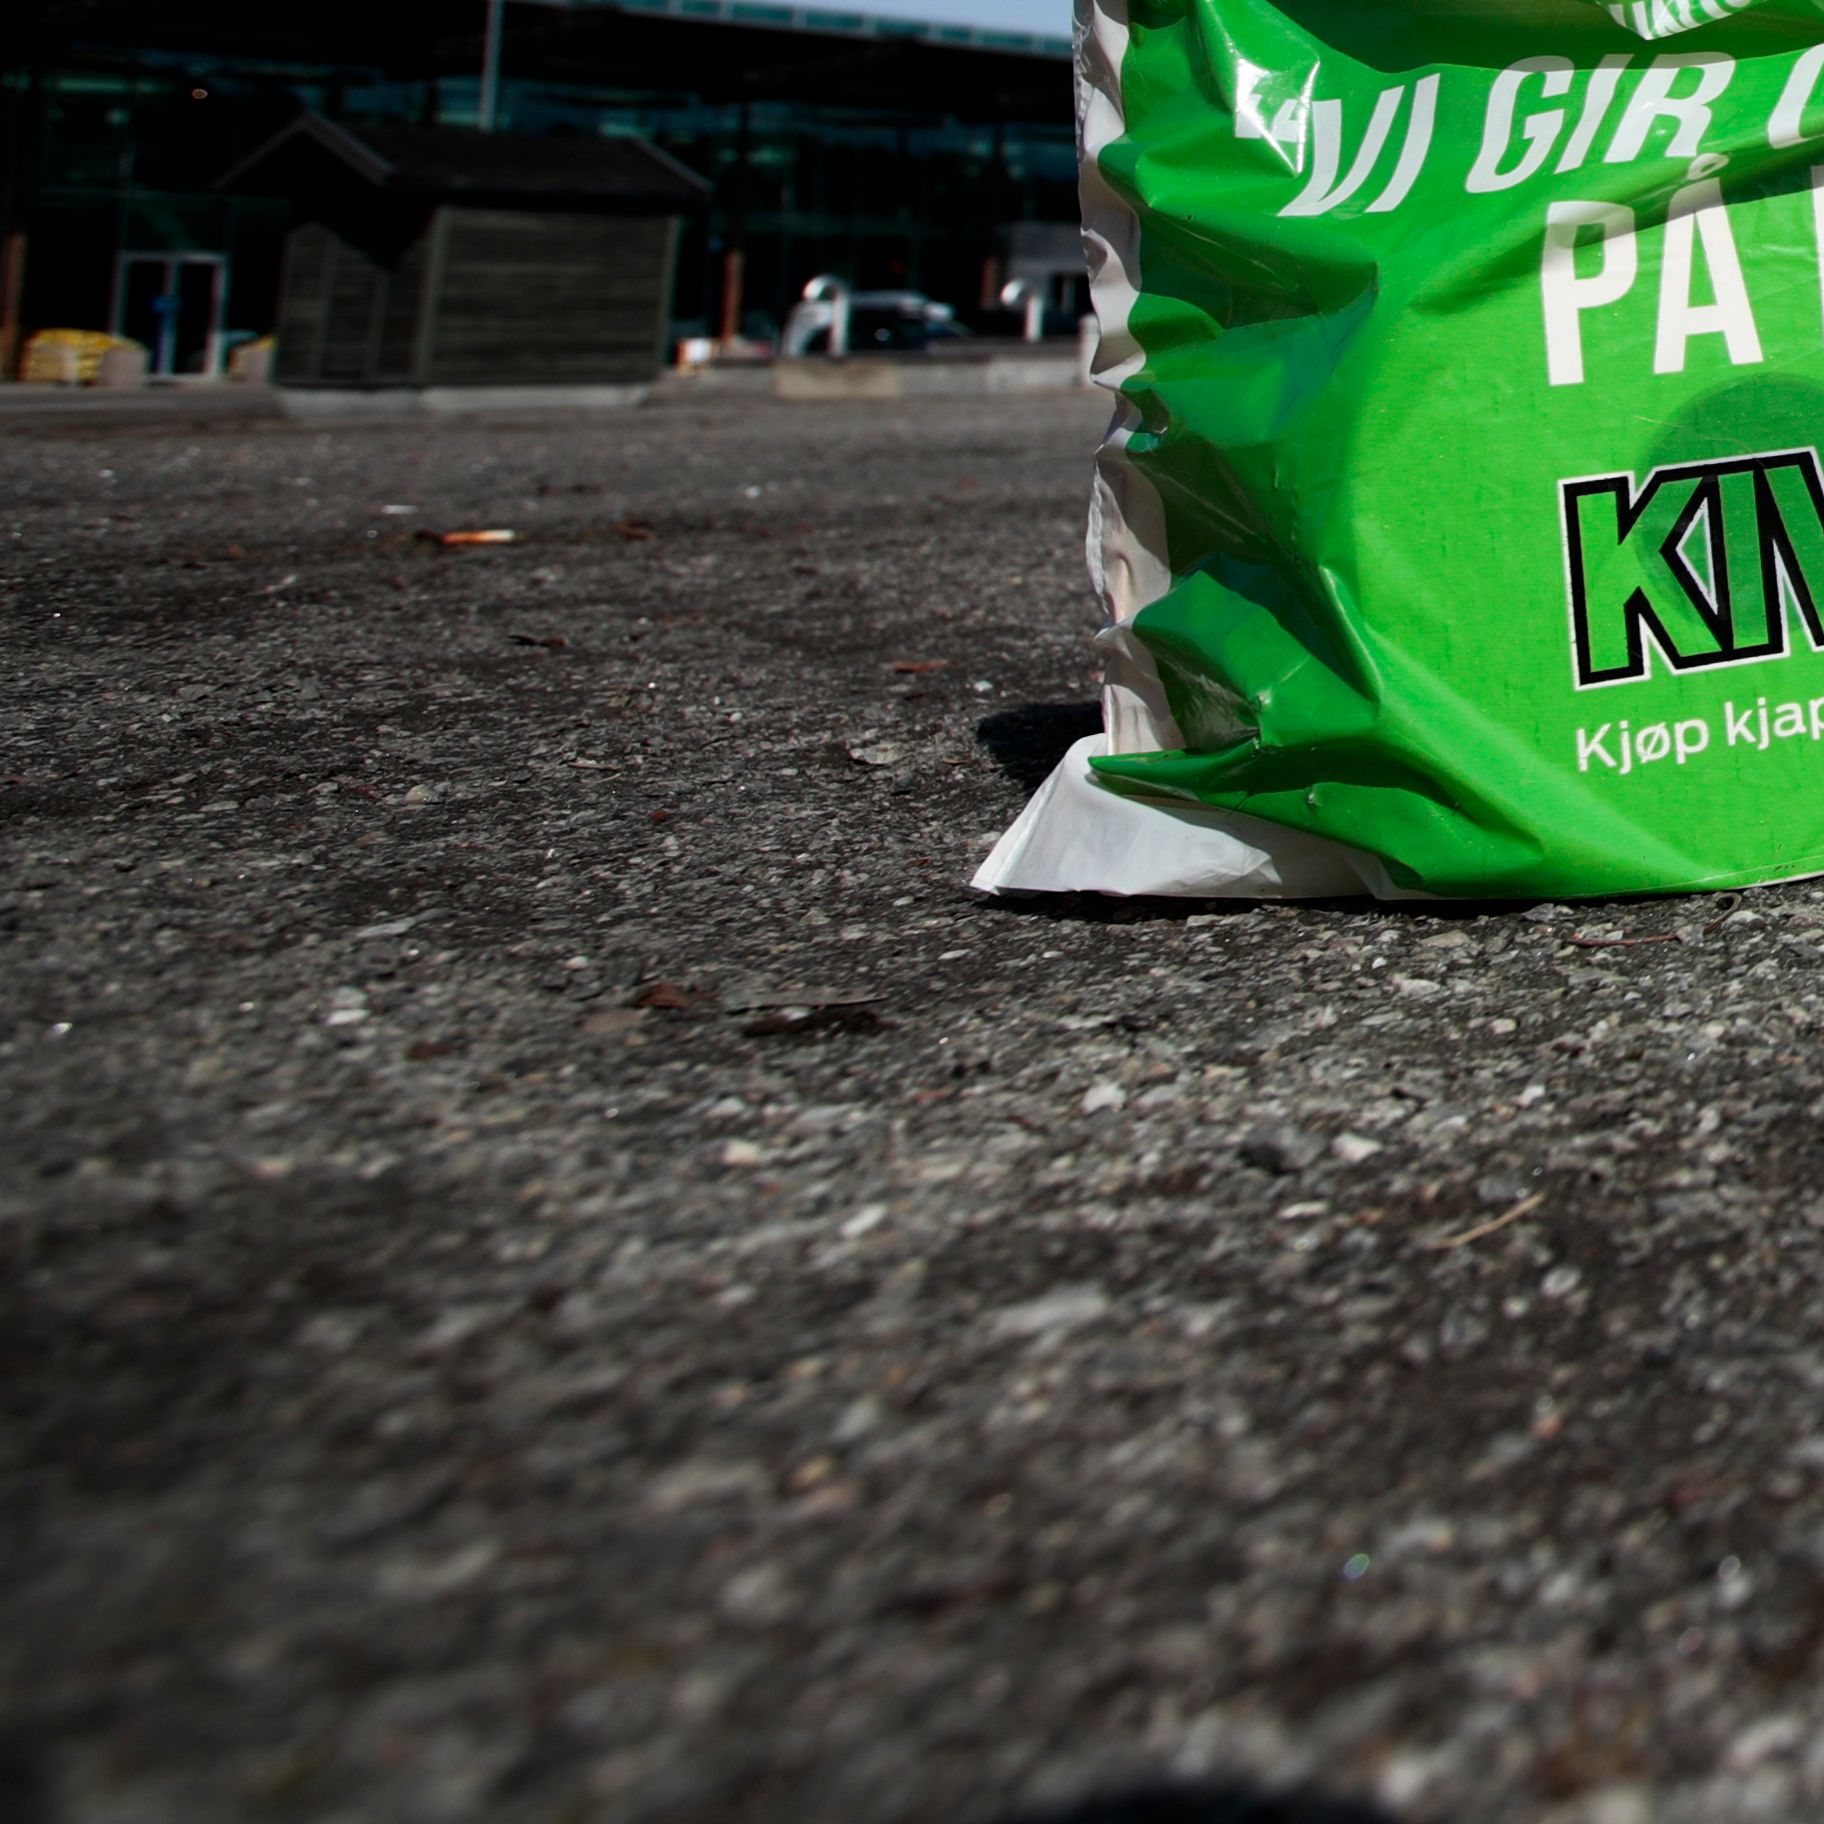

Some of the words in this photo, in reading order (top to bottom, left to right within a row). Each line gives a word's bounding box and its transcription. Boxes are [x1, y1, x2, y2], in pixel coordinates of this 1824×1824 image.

[1463, 52, 1737, 194] GIR
[1540, 152, 1764, 387] PÅ
[1575, 716, 1709, 775] Kjøp
